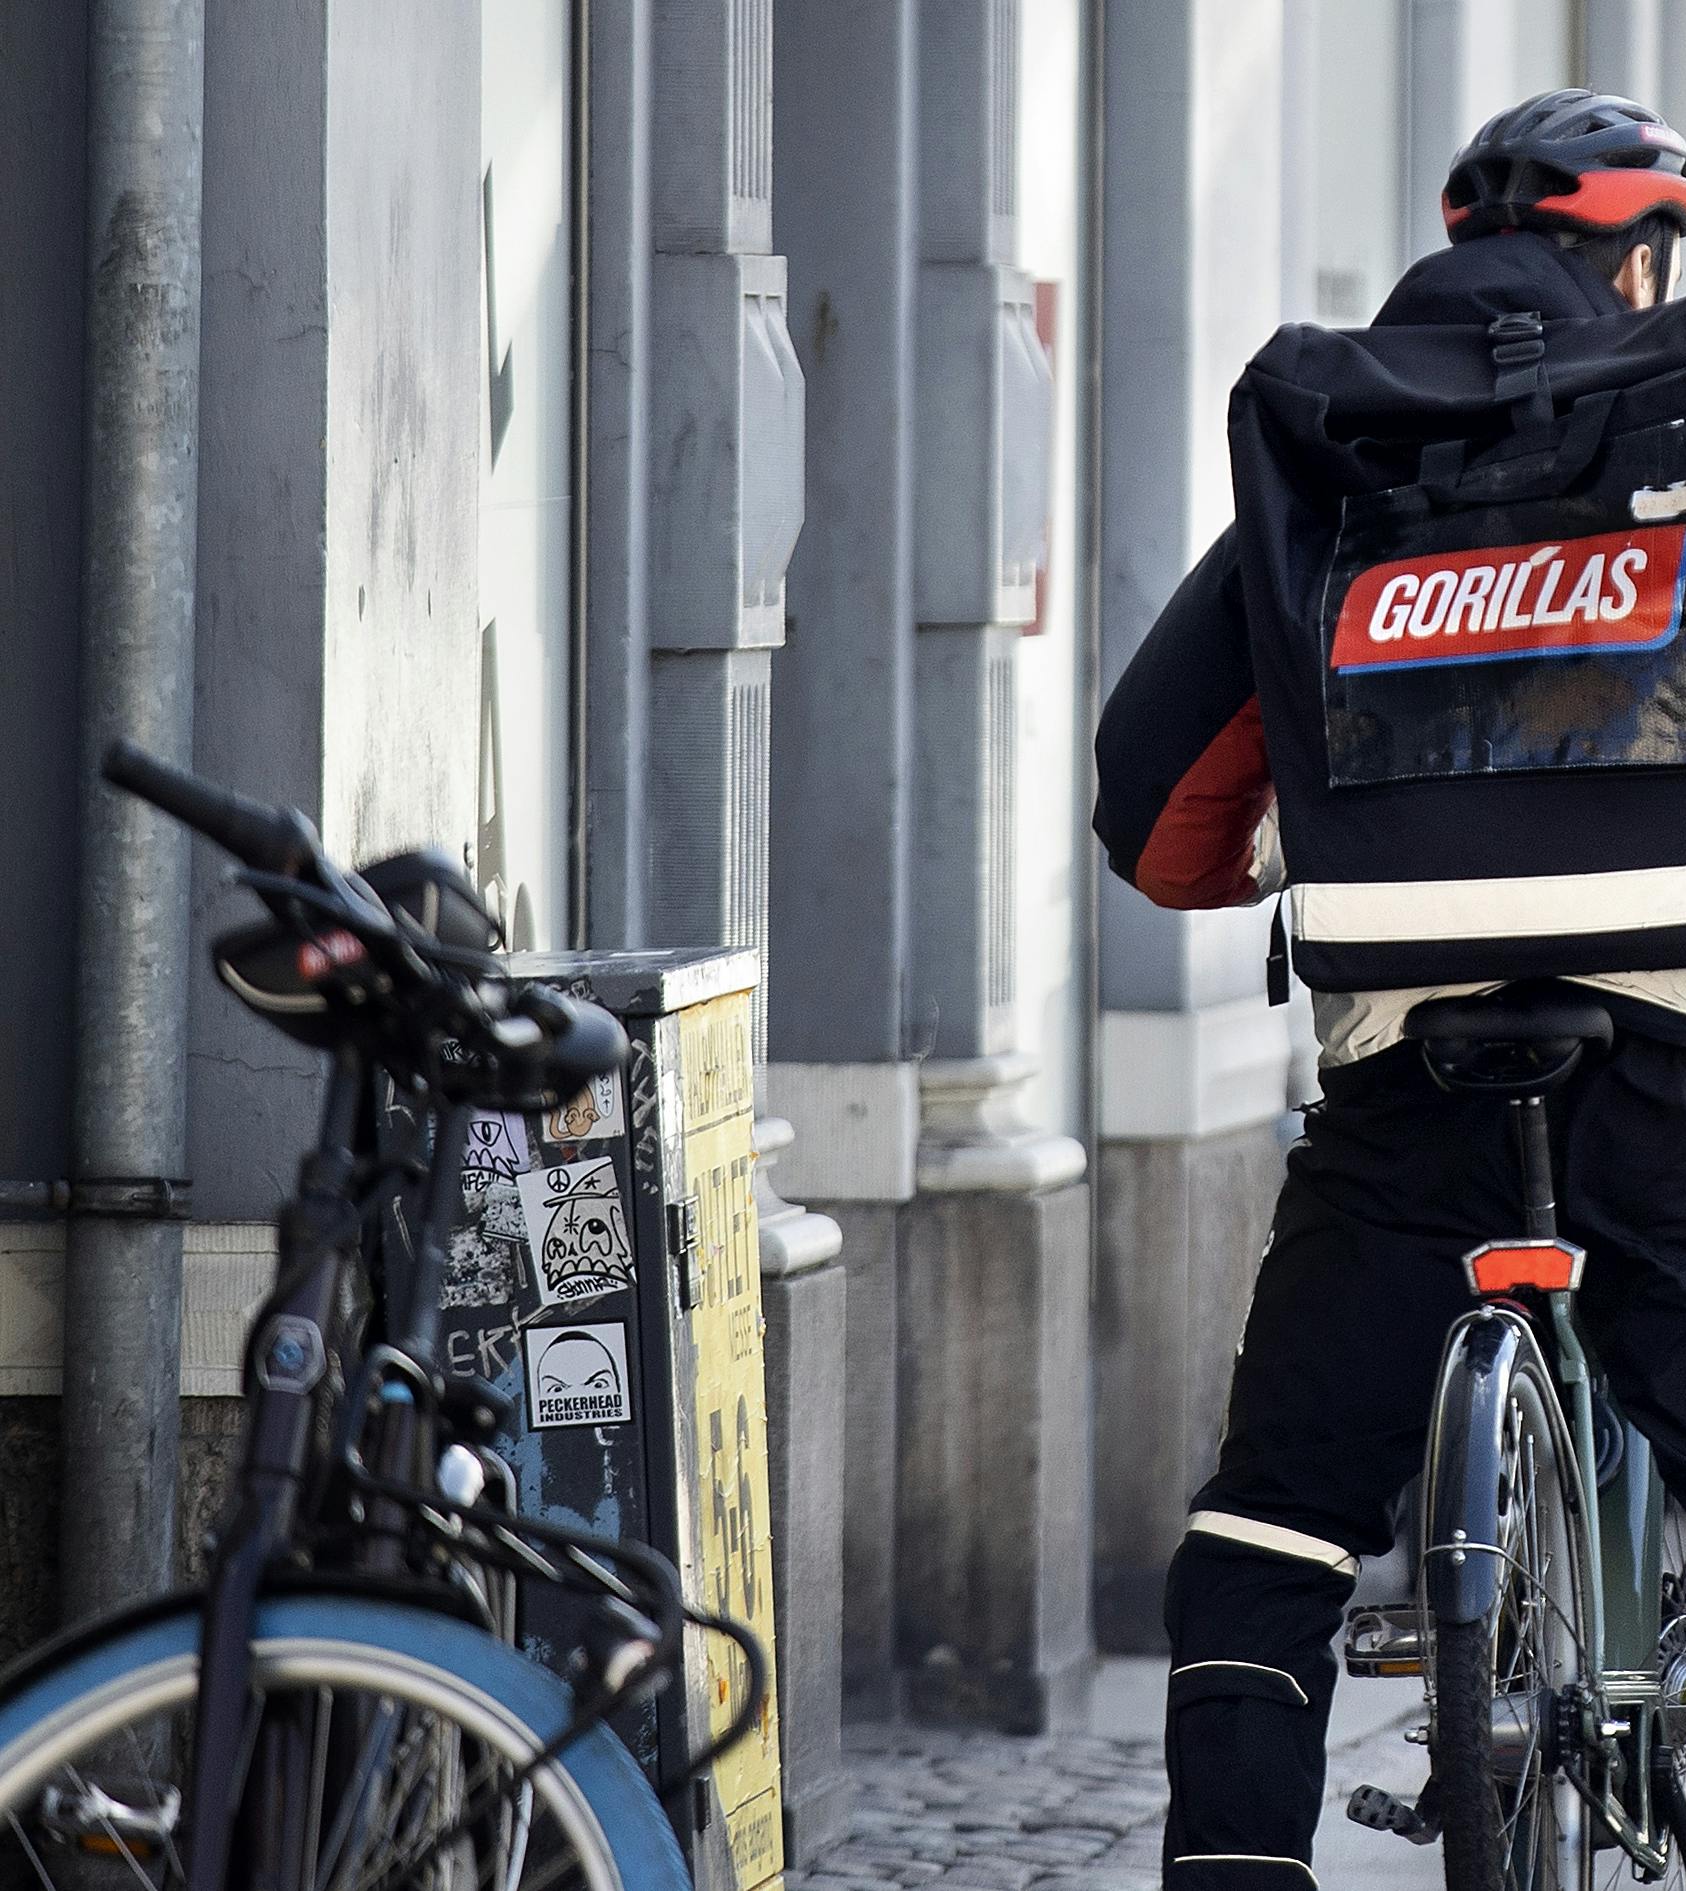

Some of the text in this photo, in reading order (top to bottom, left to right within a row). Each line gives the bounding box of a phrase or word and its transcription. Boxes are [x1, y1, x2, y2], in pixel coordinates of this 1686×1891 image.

[1369, 548, 1648, 641] GORILLAS
[539, 1394, 622, 1413] PECKERHEAD
[540, 1408, 623, 1422] INDUSTRIES
